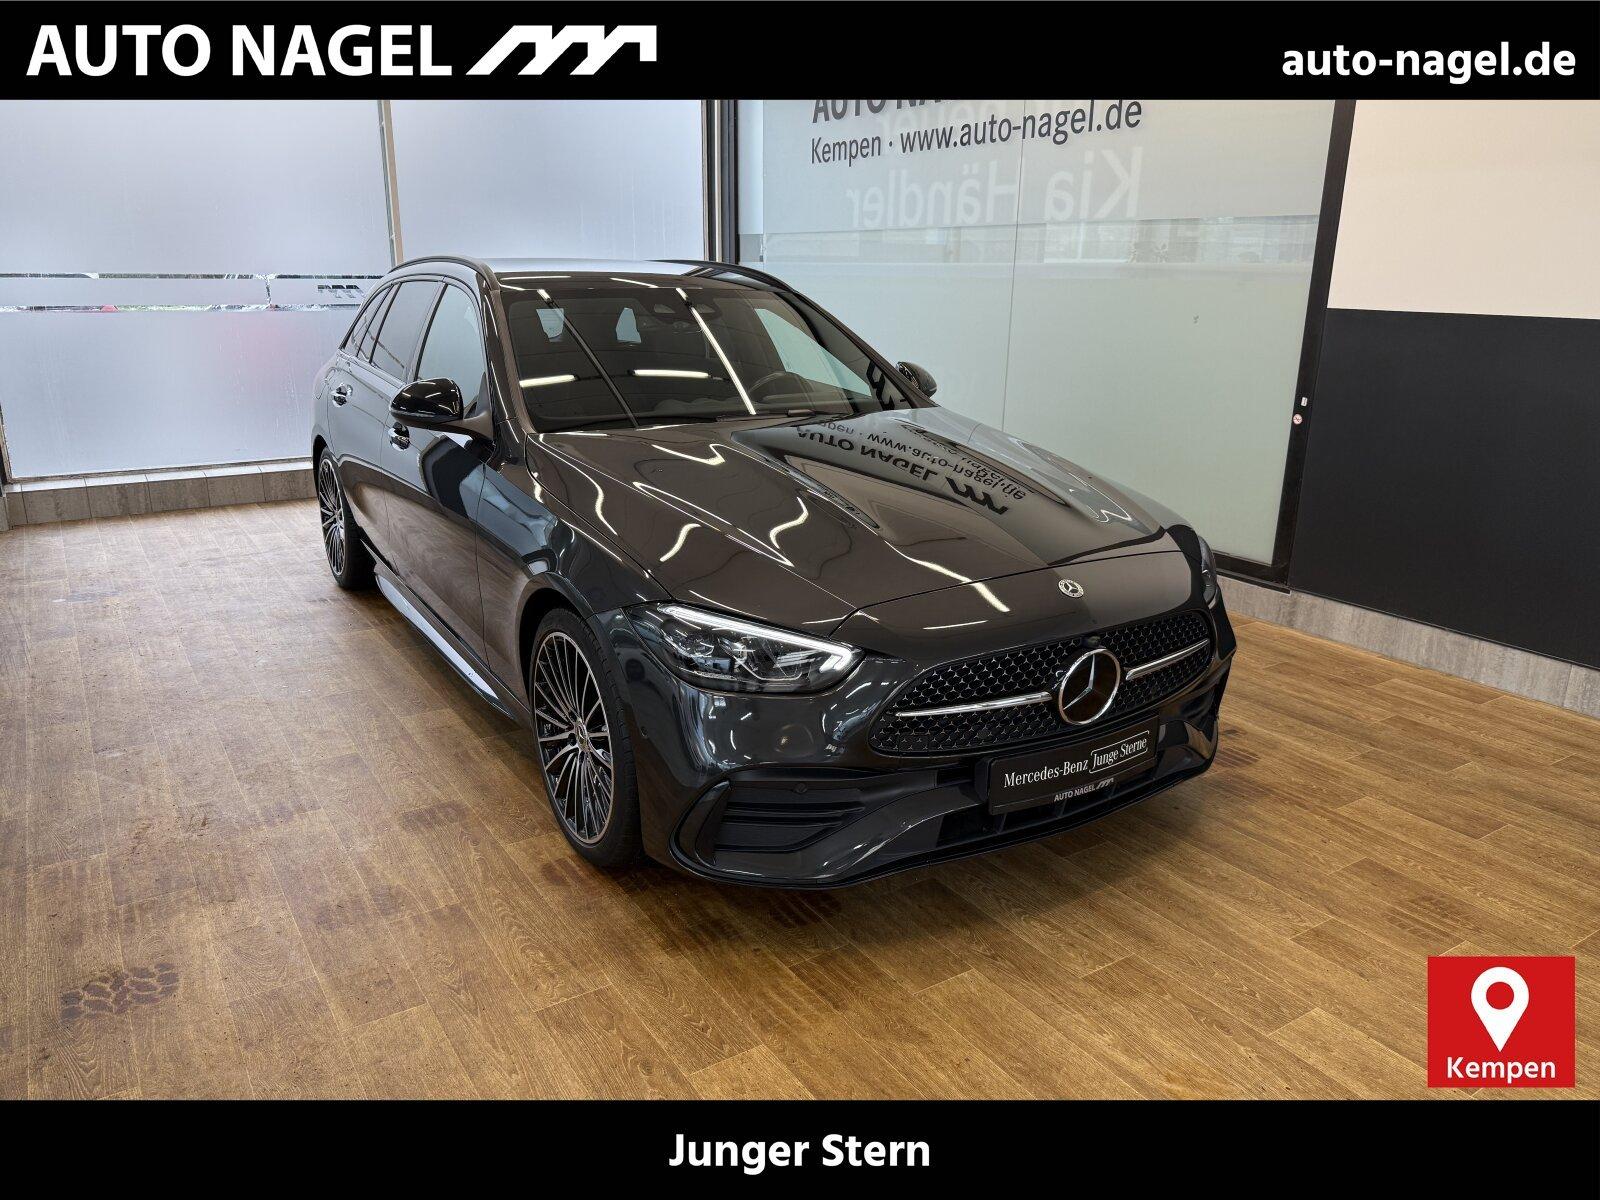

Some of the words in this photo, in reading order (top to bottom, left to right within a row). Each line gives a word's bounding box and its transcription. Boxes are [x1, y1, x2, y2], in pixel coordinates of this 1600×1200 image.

[811, 136, 881, 167] Kempen
[900, 99, 1142, 153] www.auto-nagel.de
[1004, 759, 1089, 788] Mercedes-Benz
[1093, 750, 1118, 769] Junge
[1120, 738, 1147, 757] Sterne
[1054, 790, 1073, 802] AUTO
[1074, 784, 1096, 796] NAGEL
